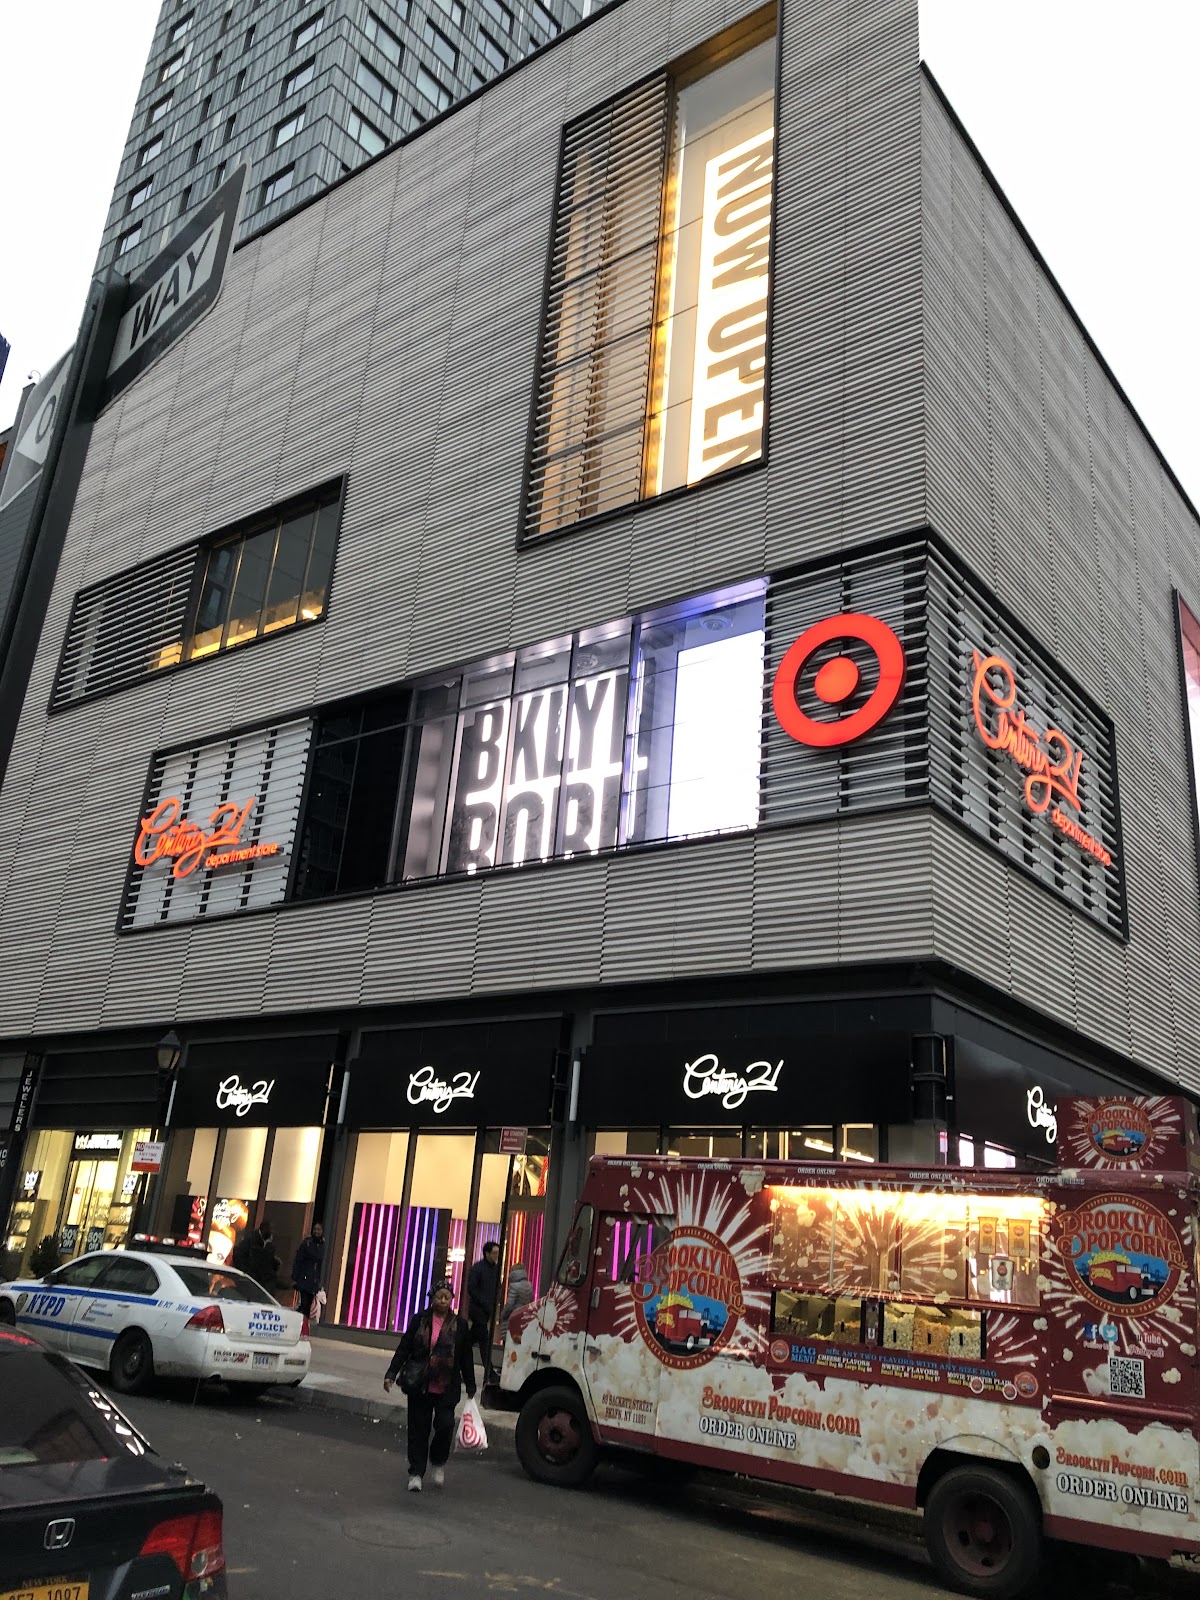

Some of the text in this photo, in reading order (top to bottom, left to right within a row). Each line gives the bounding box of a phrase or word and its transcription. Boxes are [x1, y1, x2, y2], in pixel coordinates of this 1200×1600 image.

[130, 228, 214, 350] WAY
[972, 649, 1083, 813] Century 21
[135, 797, 255, 878] Century 21
[205, 842, 279, 868] department store
[407, 1066, 481, 1113] Century 21
[683, 1053, 784, 1110] Century 21
[14, 1070, 33, 1132] JEWELERS
[216, 1075, 275, 1116] Century 21
[1087, 1109, 1145, 1123] BROOKLYN
[136, 1142, 145, 1151] NO
[797, 1167, 815, 1175] ORDER
[909, 1171, 952, 1180] ORDER ONLINE
[62, 1228, 76, 1240] 50%
[1056, 1210, 1169, 1240] BROOKLYN
[63, 1239, 74, 1248] OFF
[1056, 1231, 1170, 1261] POPCORN
[636, 1244, 735, 1288] BROOKLYN
[26, 1294, 66, 1317] NYPD
[253, 1312, 281, 1322] NYPD
[248, 1321, 285, 1333] POLICE
[791, 1344, 816, 1356] BAG
[790, 1354, 815, 1365] MENU
[817, 1353, 870, 1367] CHEESE FLAVORS
[842, 1350, 858, 1358] ANY
[860, 1352, 877, 1361] TWO
[879, 1355, 914, 1366] FLAVORS
[916, 1360, 937, 1369] WITH
[939, 1363, 957, 1372] ANY
[958, 1366, 978, 1375] SIZE
[980, 1369, 997, 1378] BAG
[882, 1362, 939, 1376] SWEET FLAVORS
[947, 1371, 966, 1381] MOVIE
[633, 1398, 654, 1412] STREET
[699, 1416, 797, 1450] ORDER ONLINE
[1057, 1472, 1189, 1514] ORDER ONLINE
[22, 1575, 68, 1588] NEW YORK
